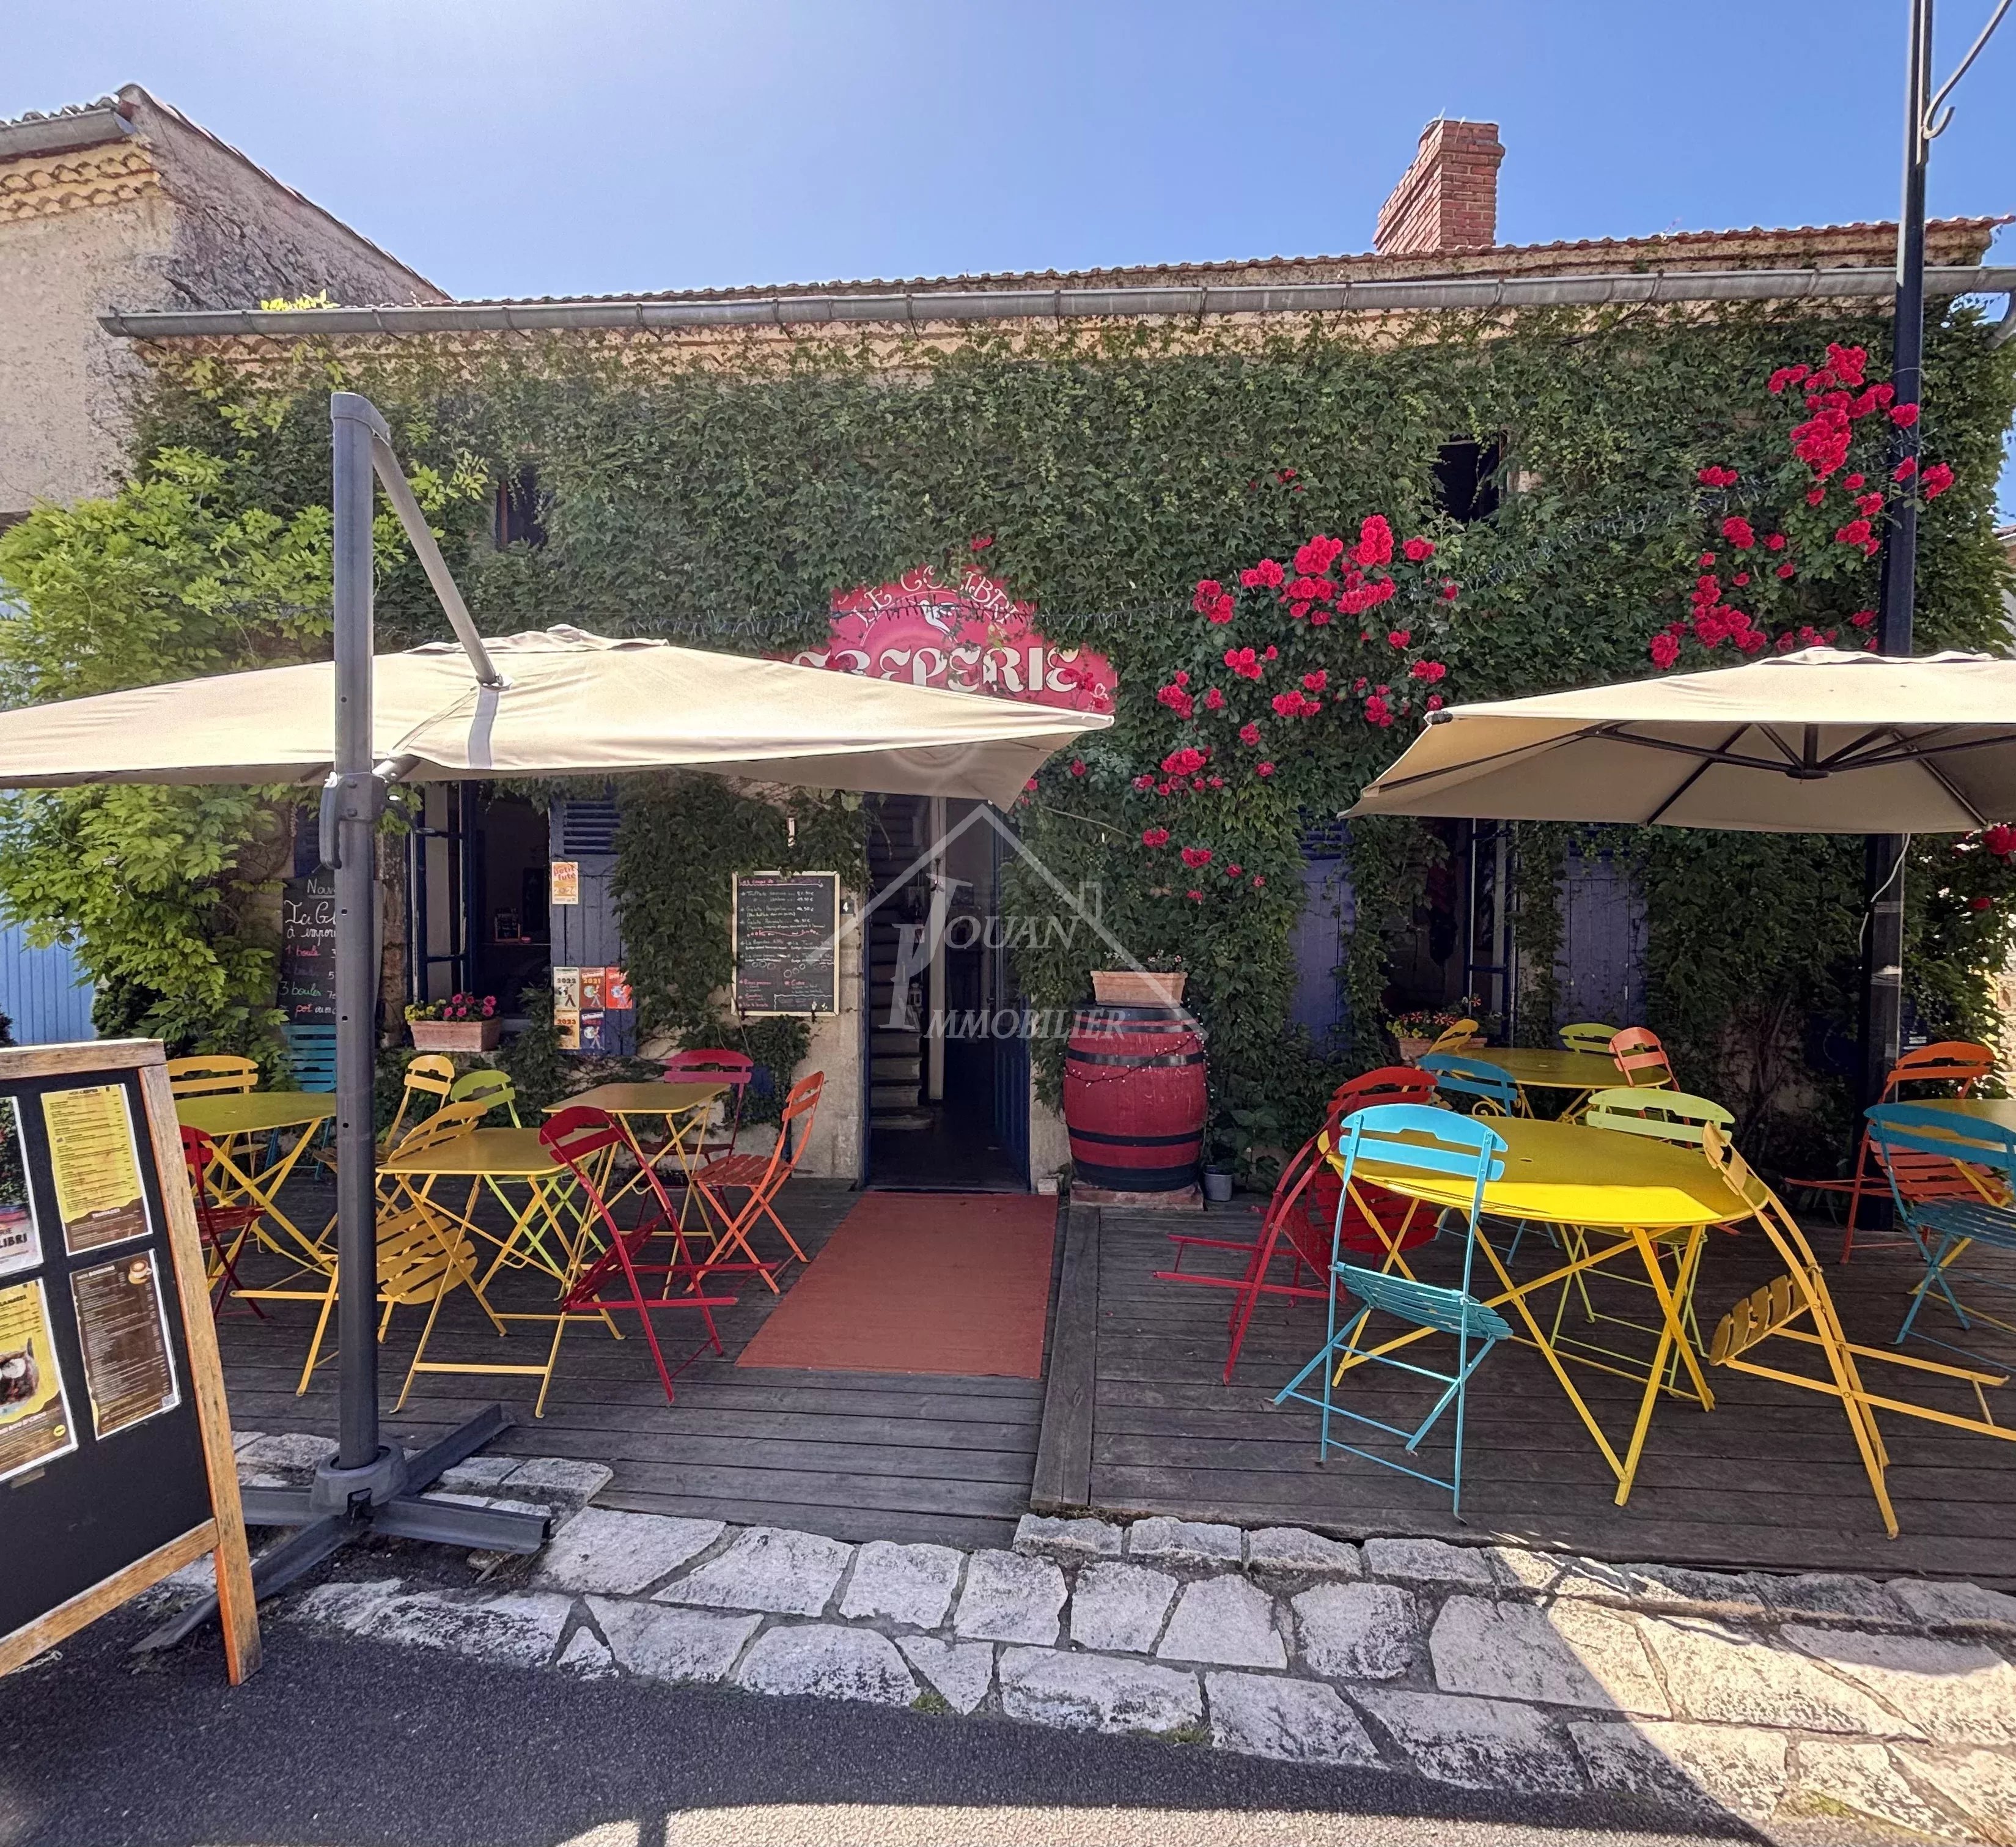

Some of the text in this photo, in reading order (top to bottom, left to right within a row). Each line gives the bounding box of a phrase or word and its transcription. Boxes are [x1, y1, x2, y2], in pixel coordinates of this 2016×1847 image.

[851, 565, 1019, 628] LE COIBRI
[307, 877, 336, 894] Nouv
[287, 925, 295, 938] à
[279, 981, 289, 995] 3
[292, 981, 322, 996] boules
